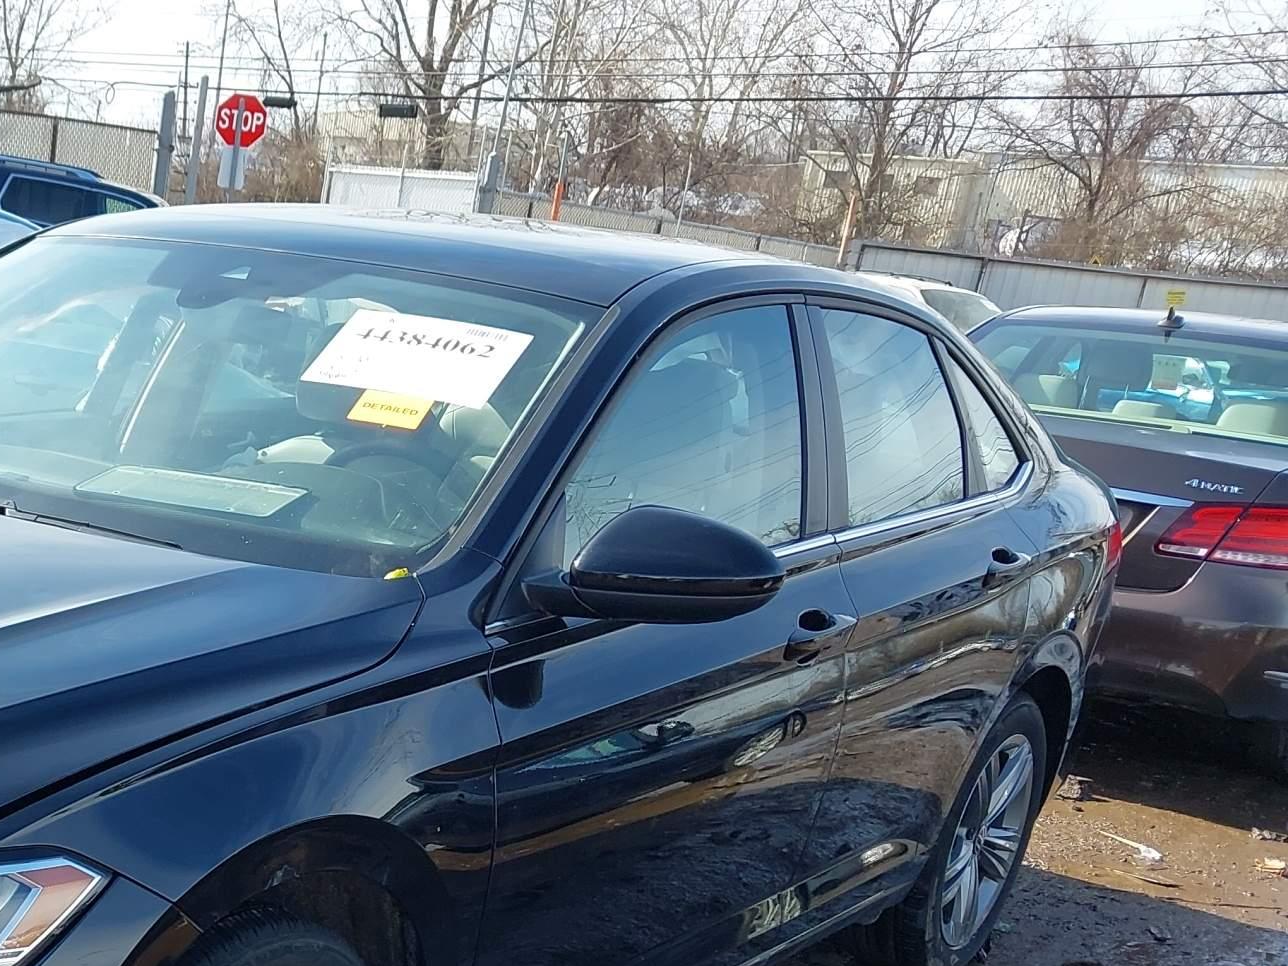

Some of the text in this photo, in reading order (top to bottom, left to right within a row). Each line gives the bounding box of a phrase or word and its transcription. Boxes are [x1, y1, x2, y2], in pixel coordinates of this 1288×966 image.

[219, 108, 264, 133] STOP
[355, 327, 496, 358] 44384062
[362, 402, 418, 416] DETAILED
[1184, 478, 1244, 495] 4MATIC
